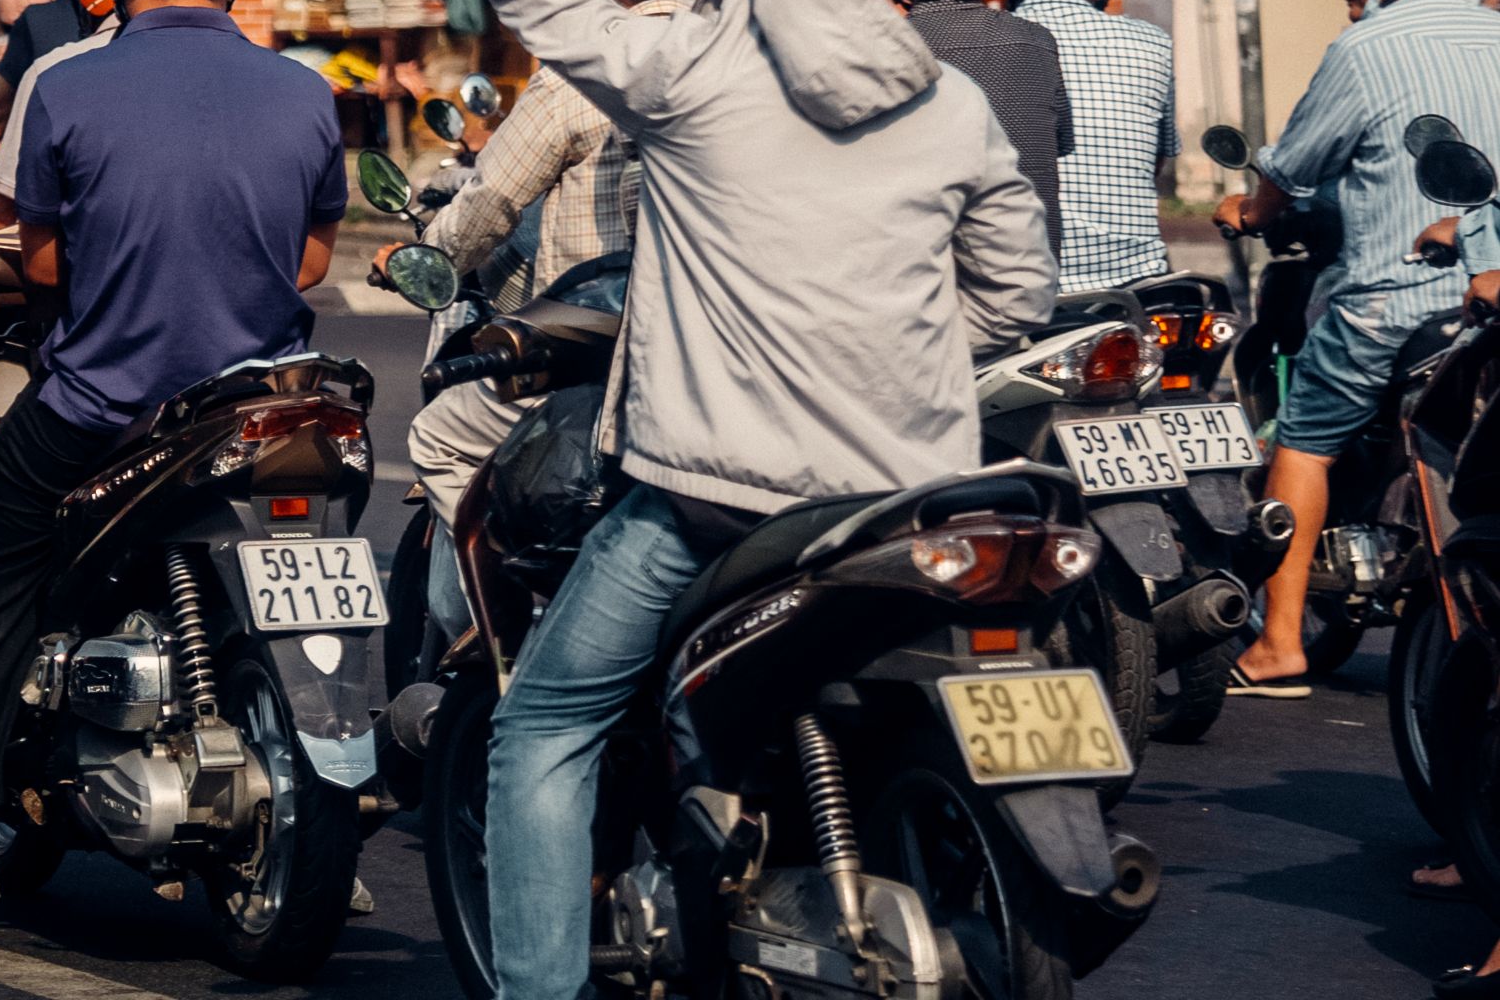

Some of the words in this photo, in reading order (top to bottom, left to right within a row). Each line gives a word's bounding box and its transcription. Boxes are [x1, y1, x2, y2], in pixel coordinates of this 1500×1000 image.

[1072, 421, 1153, 455] 59-M1
[1159, 410, 1232, 436] 59-H1
[1080, 452, 1177, 489] 466.35
[260, 546, 356, 582] 59-L2
[258, 584, 378, 623] 211.82
[978, 661, 1034, 670] HONDA
[964, 680, 1082, 726] 59-U1
